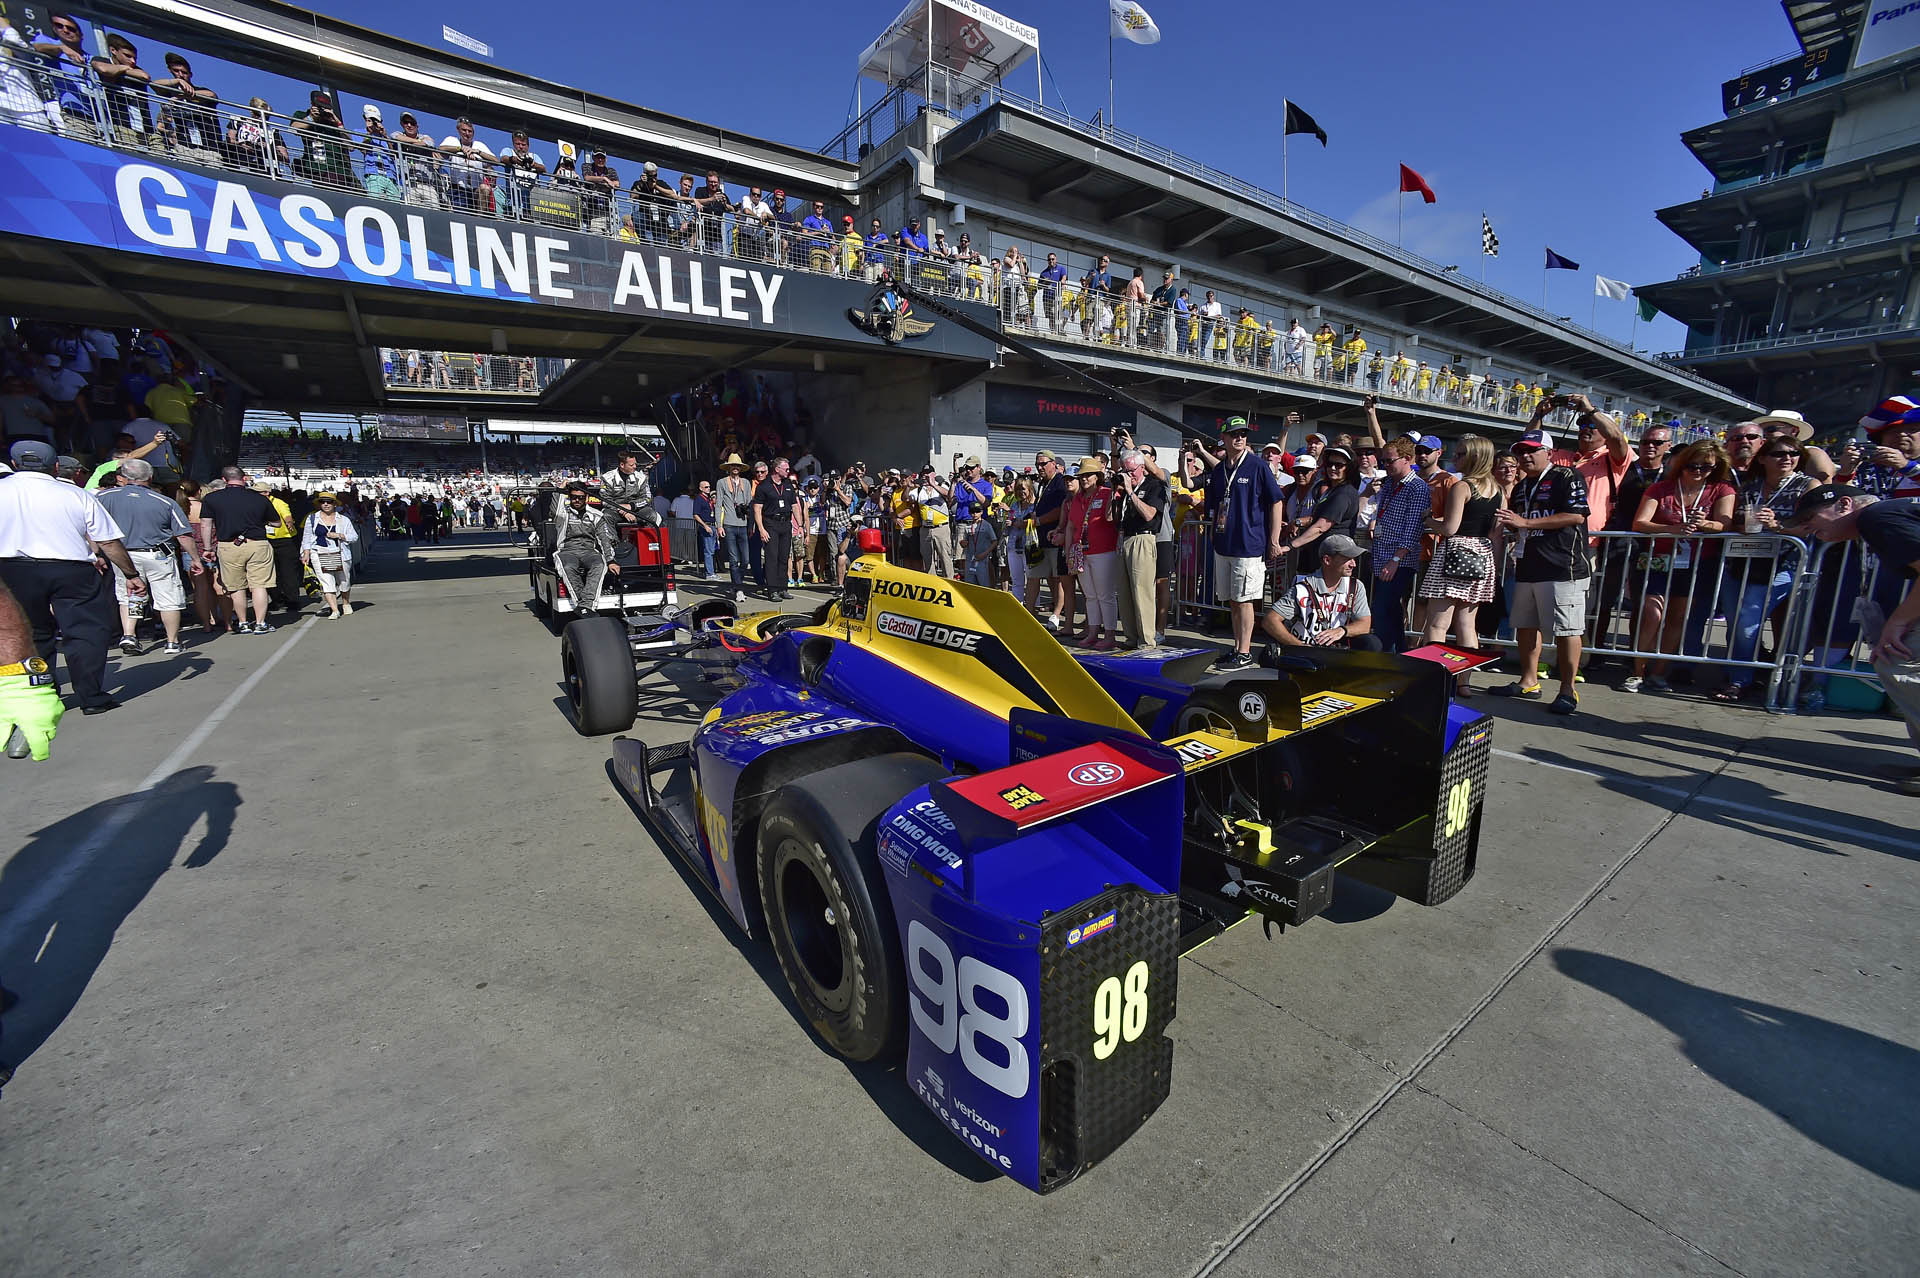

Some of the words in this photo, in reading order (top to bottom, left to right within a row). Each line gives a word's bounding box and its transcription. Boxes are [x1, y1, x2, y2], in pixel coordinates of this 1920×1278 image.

[979, 7, 1004, 27] NEWS
[1005, 20, 1036, 43] LEADER
[1733, 93, 1742, 107] 1
[1754, 85, 1767, 100] 2
[1780, 76, 1793, 91] 3
[1804, 66, 1820, 82] 4
[114, 164, 574, 300] GASOLINE
[613, 250, 784, 325] ALLEY
[1036, 399, 1102, 417] Firestone
[873, 579, 955, 608] HONDA
[887, 617, 919, 637] Castrol
[920, 624, 983, 652] EDGE
[1243, 702, 1261, 715] AF
[1077, 763, 1116, 783] STP
[1002, 786, 1032, 802] FLAG
[1009, 792, 1045, 810] BLACK
[1445, 777, 1471, 838] 98
[891, 814, 926, 841] DMG
[920, 835, 963, 869] MORI
[1253, 886, 1299, 908] XTRAC
[814, 842, 867, 1031] Firestone
[907, 919, 1030, 1099] 98
[1092, 960, 1150, 1061] 98
[917, 1079, 1012, 1169] Firestone
[953, 1097, 1000, 1138] verizon
